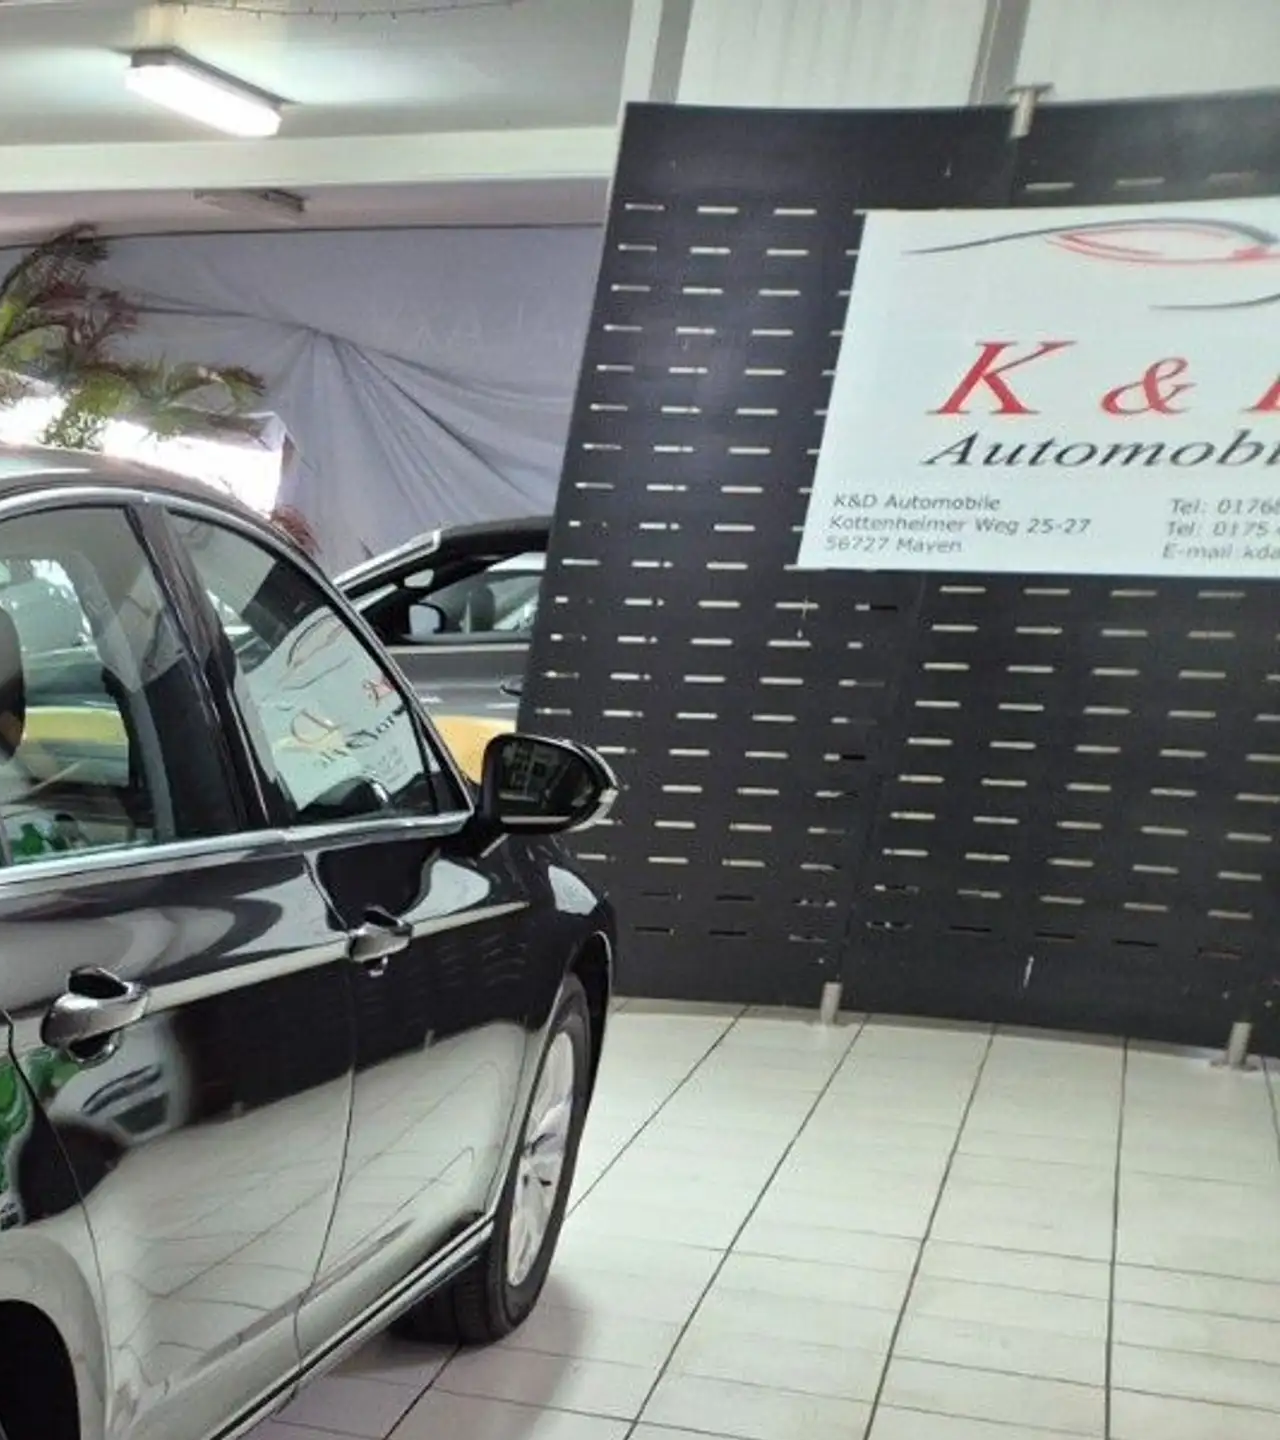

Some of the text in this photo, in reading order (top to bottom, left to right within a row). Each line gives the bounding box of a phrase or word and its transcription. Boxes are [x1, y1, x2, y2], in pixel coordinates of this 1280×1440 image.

[925, 340, 1078, 415] K
[1100, 356, 1198, 416] &
[833, 492, 1001, 511] K&D Automobile
[828, 514, 1091, 535] Kottenheimer Weg 25-27
[825, 535, 890, 552] 56727
